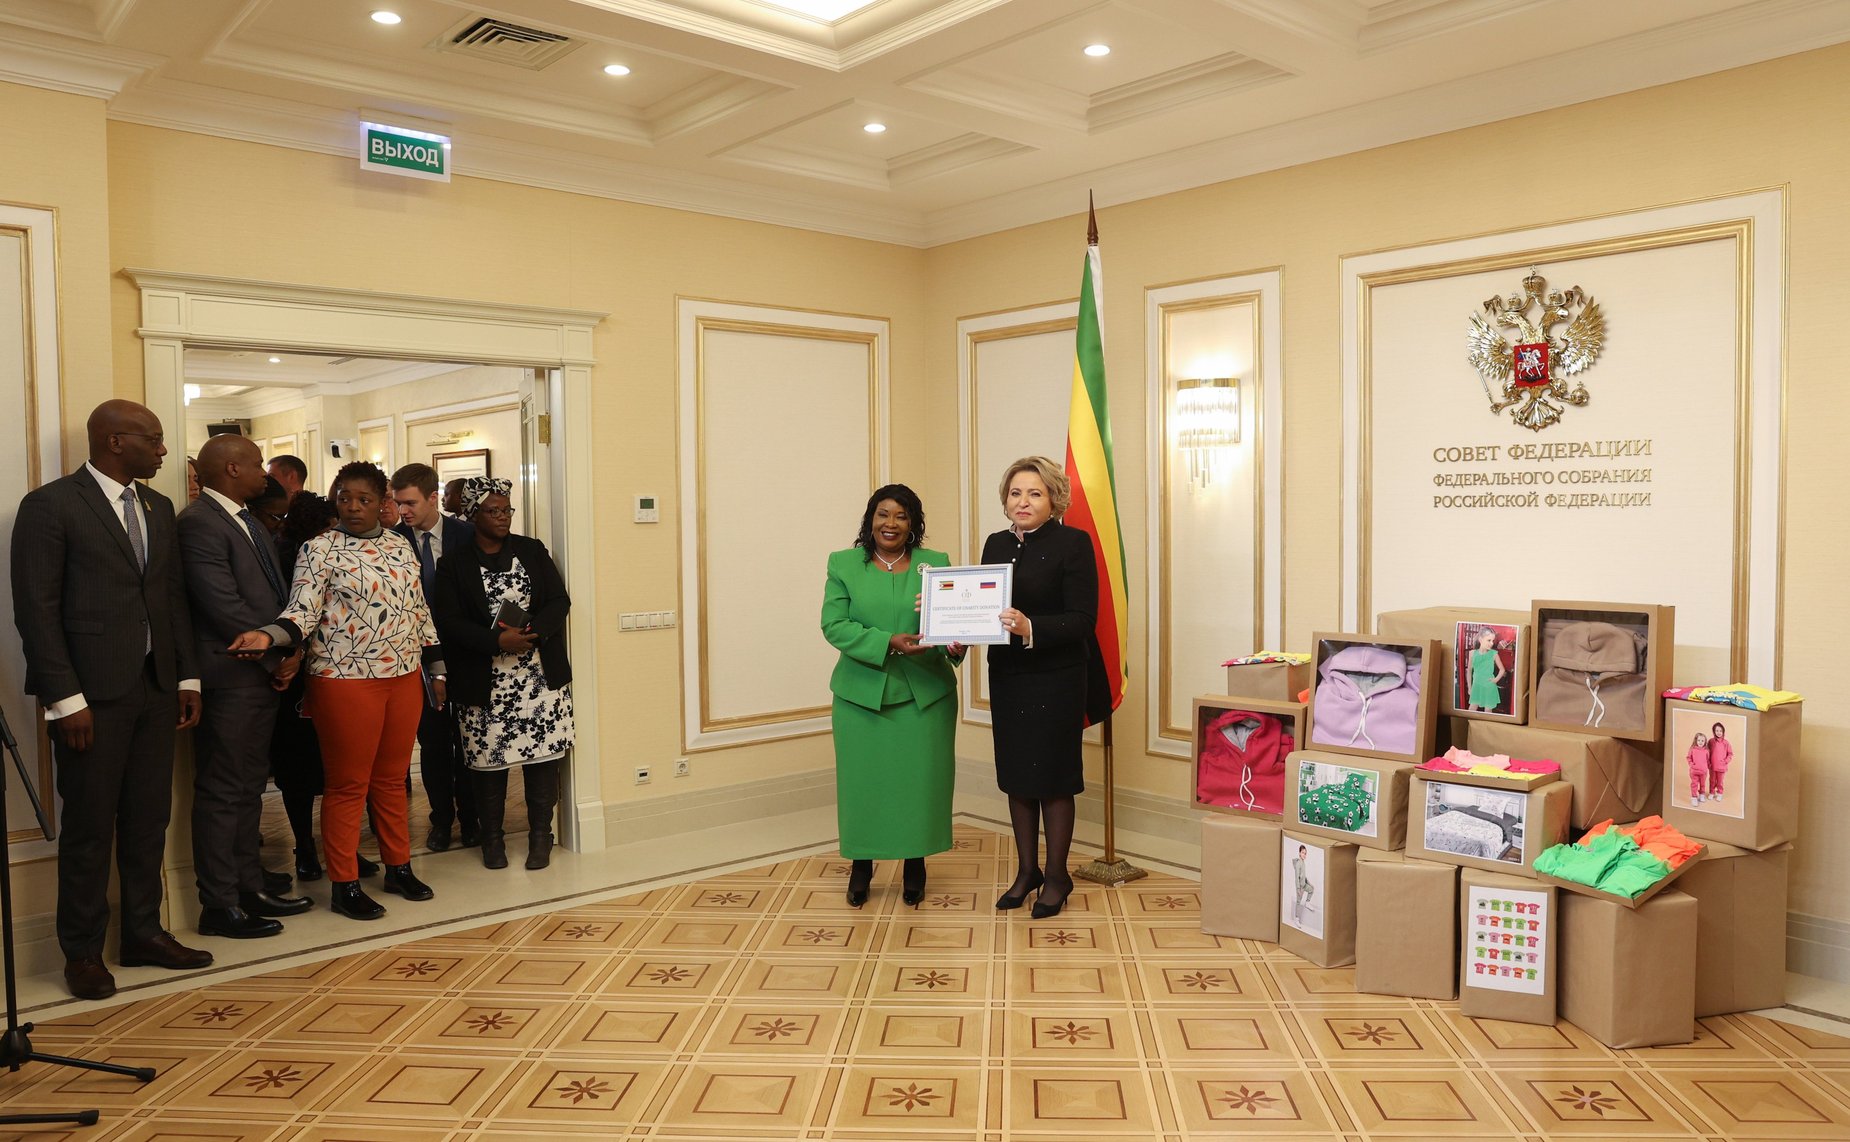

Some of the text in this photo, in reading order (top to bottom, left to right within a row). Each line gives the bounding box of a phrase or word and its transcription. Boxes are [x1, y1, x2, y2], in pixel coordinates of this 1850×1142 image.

[371, 137, 439, 168] ВЫХОД
[1433, 439, 1652, 463] СОВЕТ ФЕДЕРАЦИИ
[1433, 468, 1652, 488] ФЕДЕРАЛЬНОГО СОБРАНИЯ
[1433, 491, 1652, 509] РОССИЙСКОЙ ФЕДЕРАЦИИ
